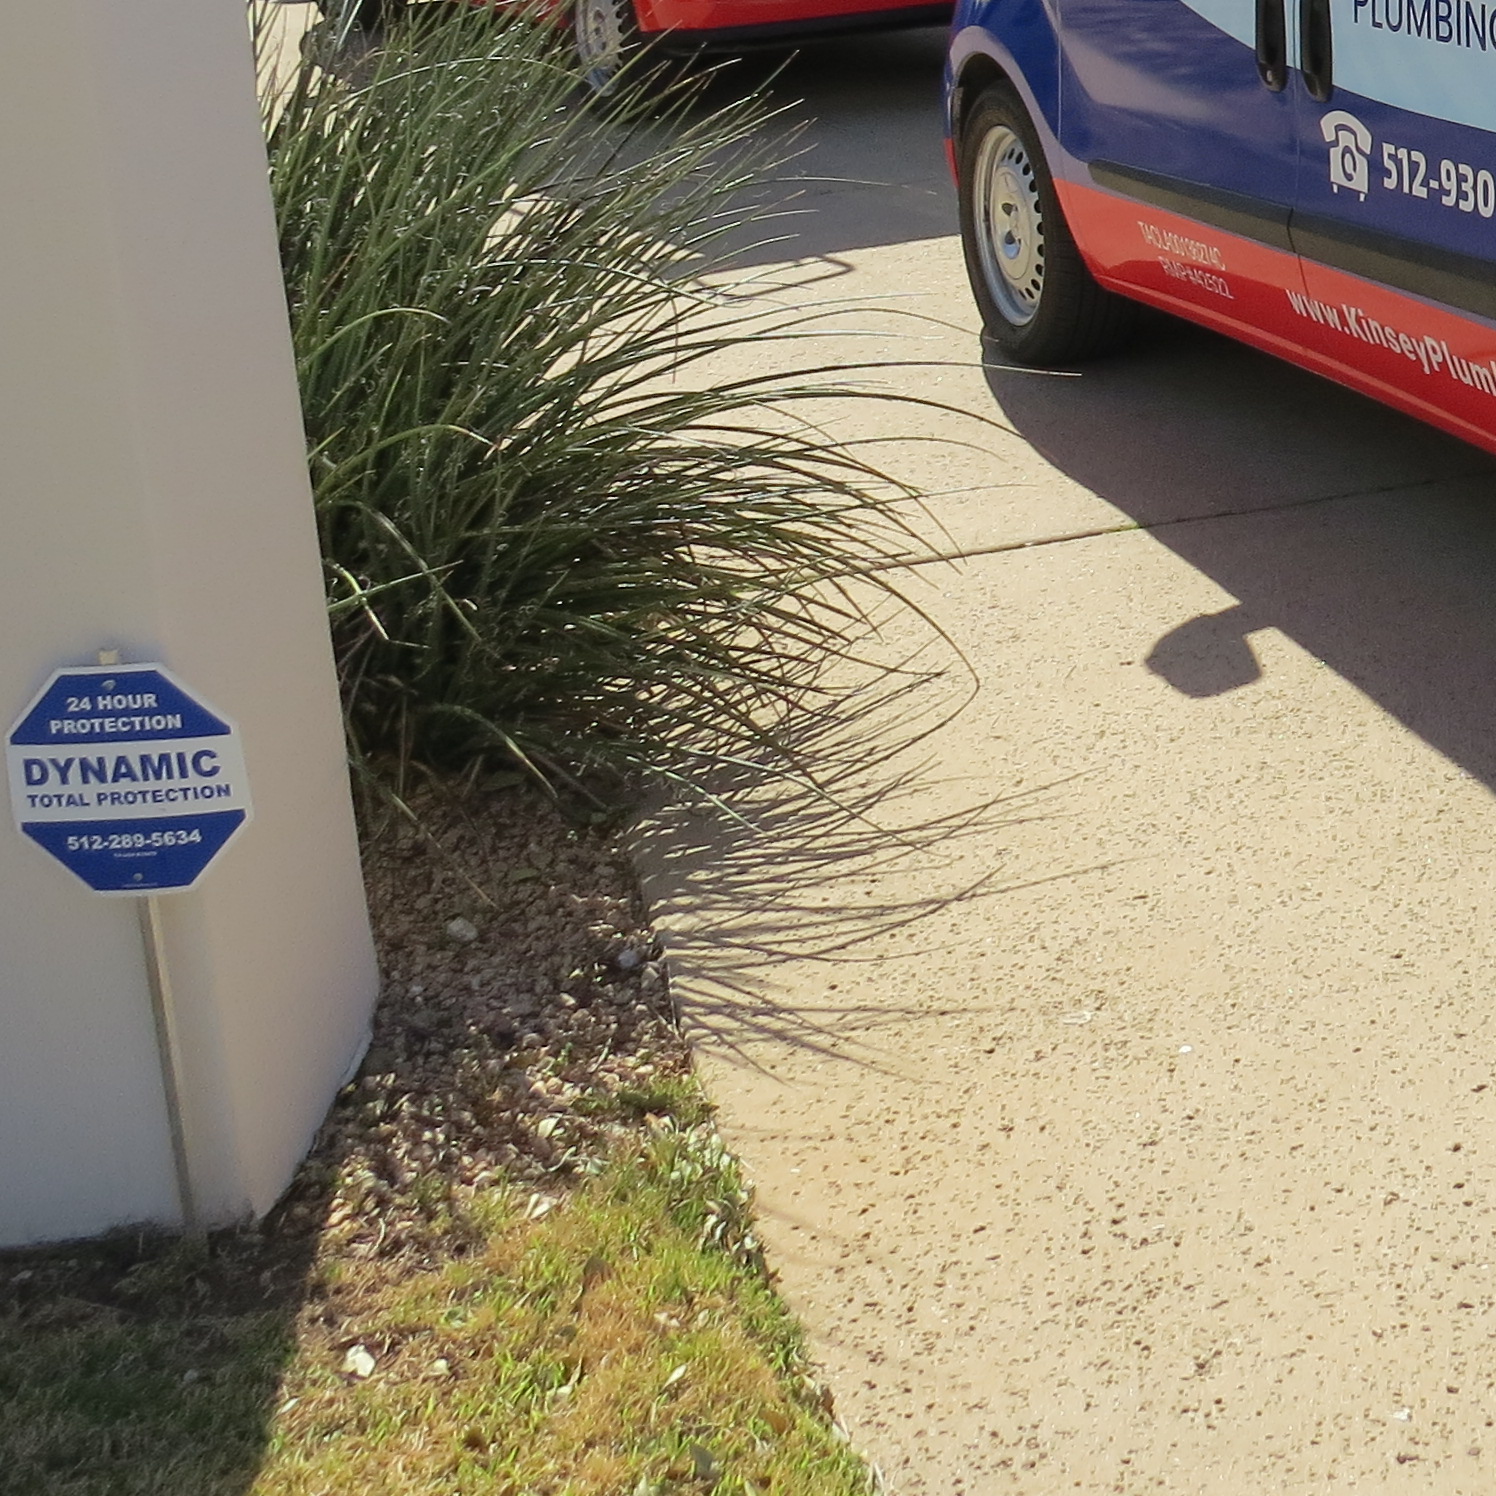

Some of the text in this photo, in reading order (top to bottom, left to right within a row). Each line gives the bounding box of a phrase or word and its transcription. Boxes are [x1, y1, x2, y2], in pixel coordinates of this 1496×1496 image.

[67, 693, 158, 712] 24 HOUR
[50, 714, 182, 735] PROTECTION
[23, 749, 222, 787] DYNAMIC
[27, 784, 231, 809] TOTAL PROTECTION
[67, 829, 202, 850] 512-289-5634
